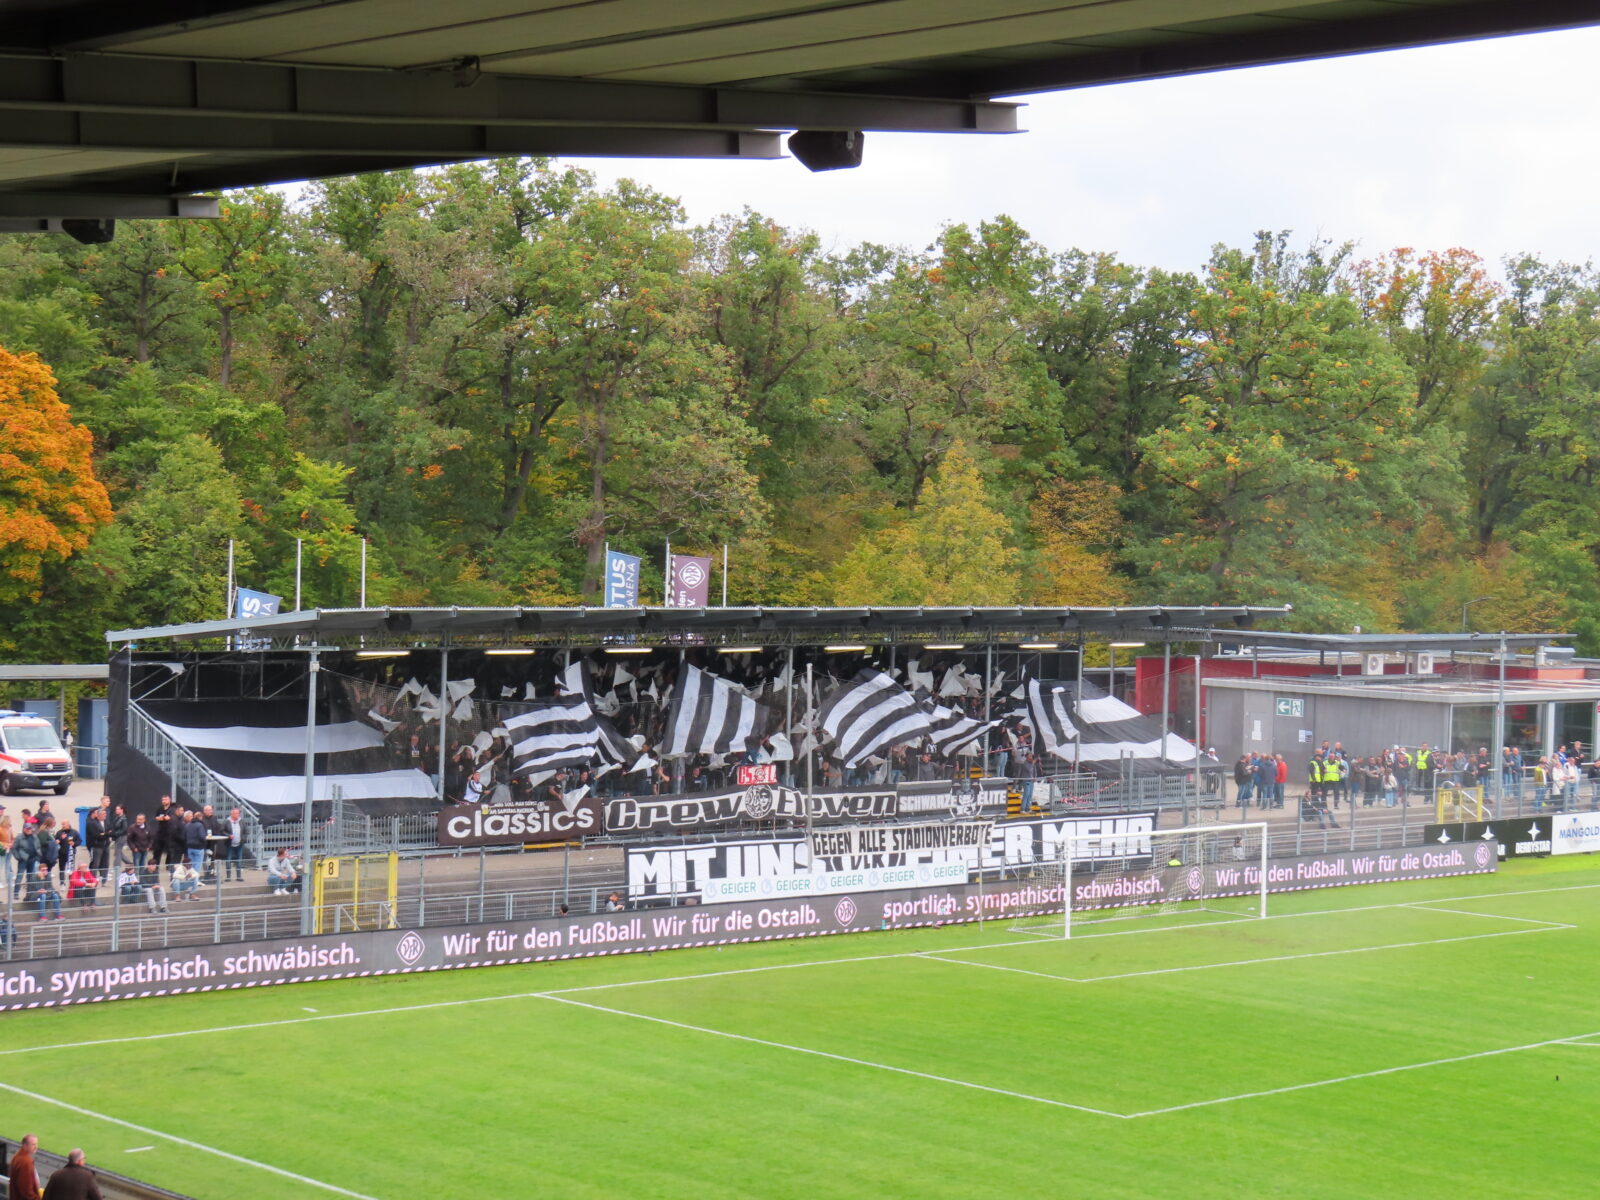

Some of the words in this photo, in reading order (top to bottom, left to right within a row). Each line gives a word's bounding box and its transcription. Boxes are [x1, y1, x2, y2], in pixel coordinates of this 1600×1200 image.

[606, 793, 743, 832] Crew
[775, 786, 898, 818] Eleven
[976, 789, 1008, 807] ELITE
[447, 807, 595, 839] classics
[1558, 826, 1600, 839] MANGOLD
[813, 830, 852, 856] GEGEN
[858, 828, 886, 852] ALLE
[893, 823, 992, 851] STADIONVERBOTE
[328, 861, 334, 875] 8
[628, 848, 716, 896] MIT
[1042, 817, 1153, 861] MEHR
[1215, 868, 1241, 887] Wir
[1268, 864, 1293, 882] den
[1297, 859, 1348, 880] Fußball.
[1352, 858, 1375, 875] Wir
[1378, 855, 1397, 872] für
[1400, 853, 1419, 871] die
[1423, 850, 1465, 868] Ostalb.
[776, 878, 811, 892] GEIGER
[830, 874, 864, 888] GEIGER
[883, 870, 915, 884] GEIGER
[934, 866, 965, 880] GEIGER
[720, 881, 756, 895] GEIGER
[1076, 876, 1164, 900] schwäbisch.
[652, 916, 687, 938] Wir
[692, 912, 720, 935] für
[724, 910, 752, 931] die
[758, 904, 821, 928] Ostalb.
[443, 933, 481, 956] Wir
[486, 930, 518, 952] für
[523, 927, 561, 949] den
[568, 918, 646, 946] Fußball.
[51, 954, 216, 997] sympathisch.
[223, 942, 361, 975] schwäbisch.
